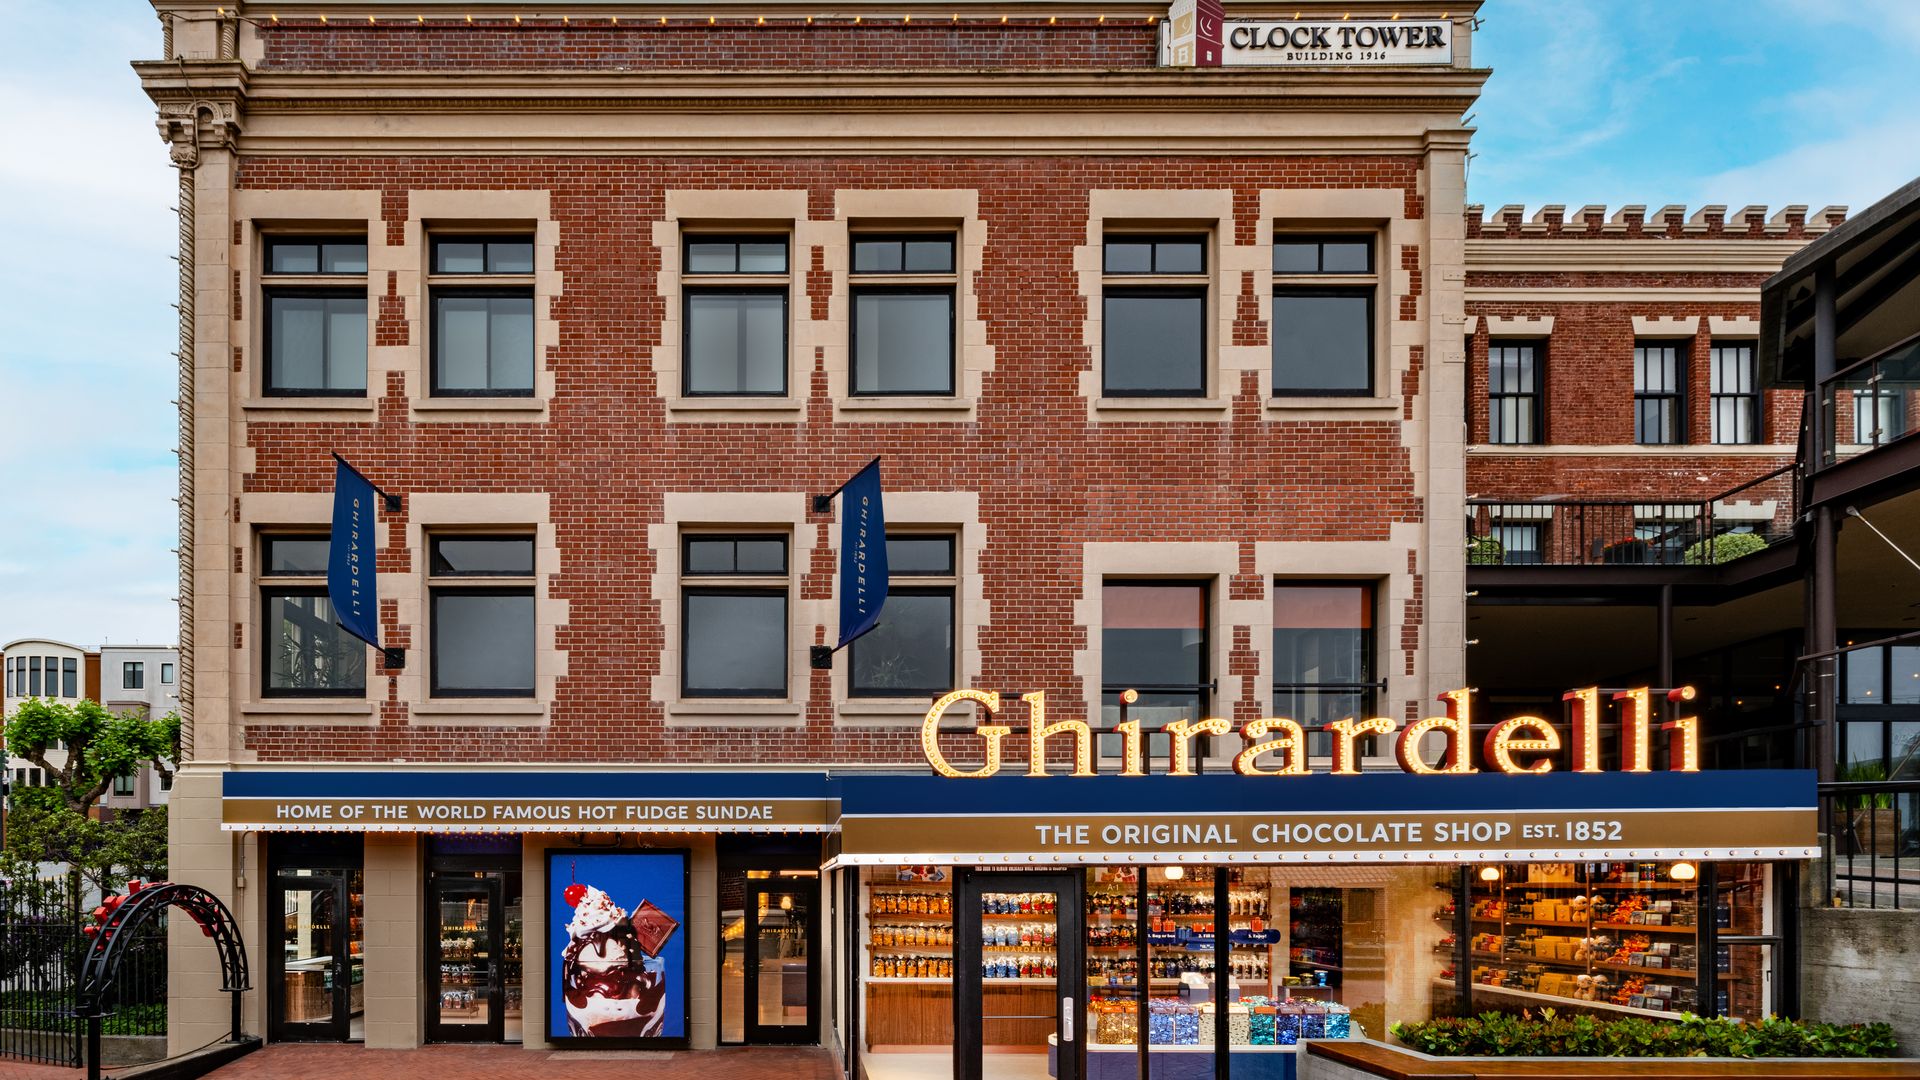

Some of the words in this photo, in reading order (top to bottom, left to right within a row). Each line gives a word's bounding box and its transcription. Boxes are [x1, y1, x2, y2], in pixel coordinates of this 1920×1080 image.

[1229, 26, 1332, 50] CLOCK
[1337, 25, 1447, 49] TOWER
[1286, 51, 1353, 61] BUILDING
[1360, 51, 1386, 61] 1916
[351, 498, 360, 615] GHIRARDELLI
[858, 496, 869, 613] GHIRARDELLI
[921, 686, 1700, 778] Ghirardelli
[276, 804, 333, 819] HOME
[339, 804, 365, 819] OF
[371, 805, 408, 819] THE
[417, 805, 487, 819] WORLD
[493, 805, 571, 820] FAMOUS
[578, 805, 618, 820] HOT
[625, 805, 689, 820] FUDGE
[696, 805, 773, 820] SUNDAE
[1035, 824, 1090, 845] THE
[1101, 823, 1238, 845] ORIGINAL
[1251, 822, 1423, 844] CHOCOLATE
[1434, 821, 1511, 843] SHOP
[1522, 824, 1560, 839] EST.
[1566, 820, 1624, 841] 1852
